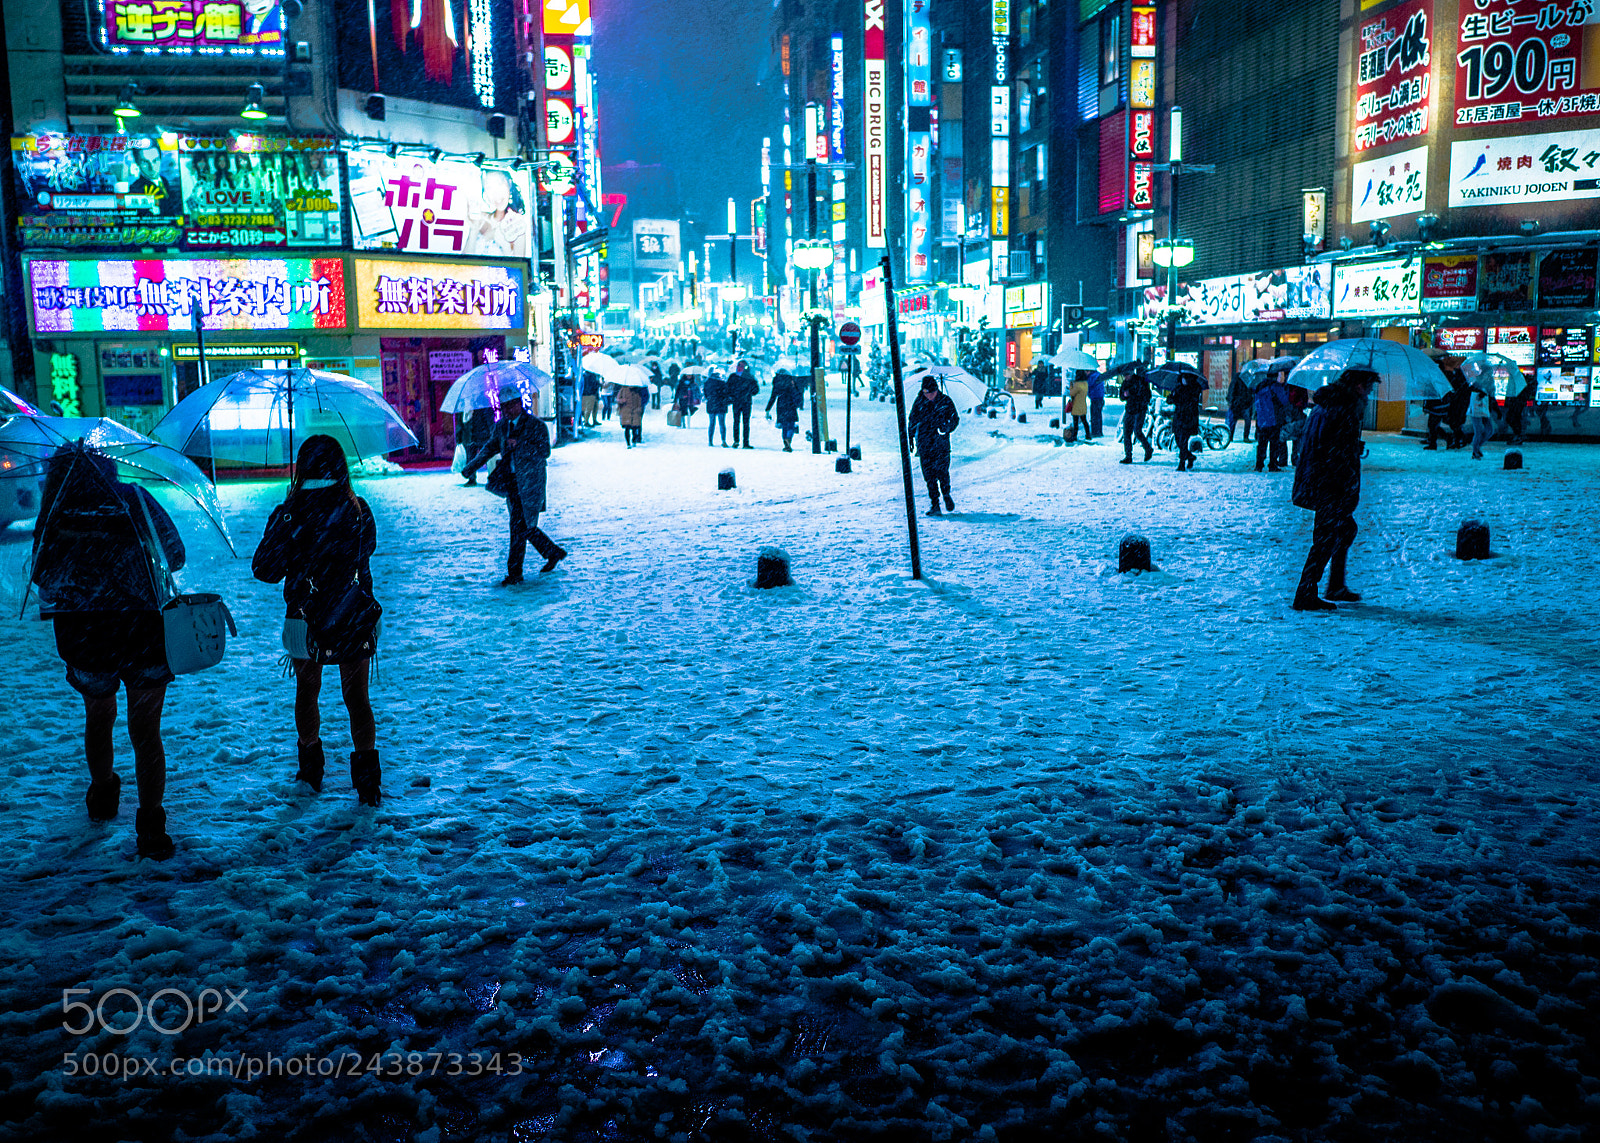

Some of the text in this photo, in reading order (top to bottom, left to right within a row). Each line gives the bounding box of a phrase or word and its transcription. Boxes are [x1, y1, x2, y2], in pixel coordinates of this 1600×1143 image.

[114, 3, 241, 41] 逆ナン館
[1462, 1, 1593, 40] 生ビールが
[869, 70, 881, 149] BIC DRUG
[1497, 154, 1532, 171] 焼肉
[206, 190, 252, 204] LOVE
[1376, 170, 1423, 206] 叙々苑
[1460, 184, 1521, 198] YAKINIKU
[1523, 181, 1568, 196] JOJOEN
[187, 229, 263, 245] ここから30秒
[396, 207, 465, 250] パラ
[376, 273, 518, 314] 無料案内所
[1372, 270, 1418, 302] 叙々苑
